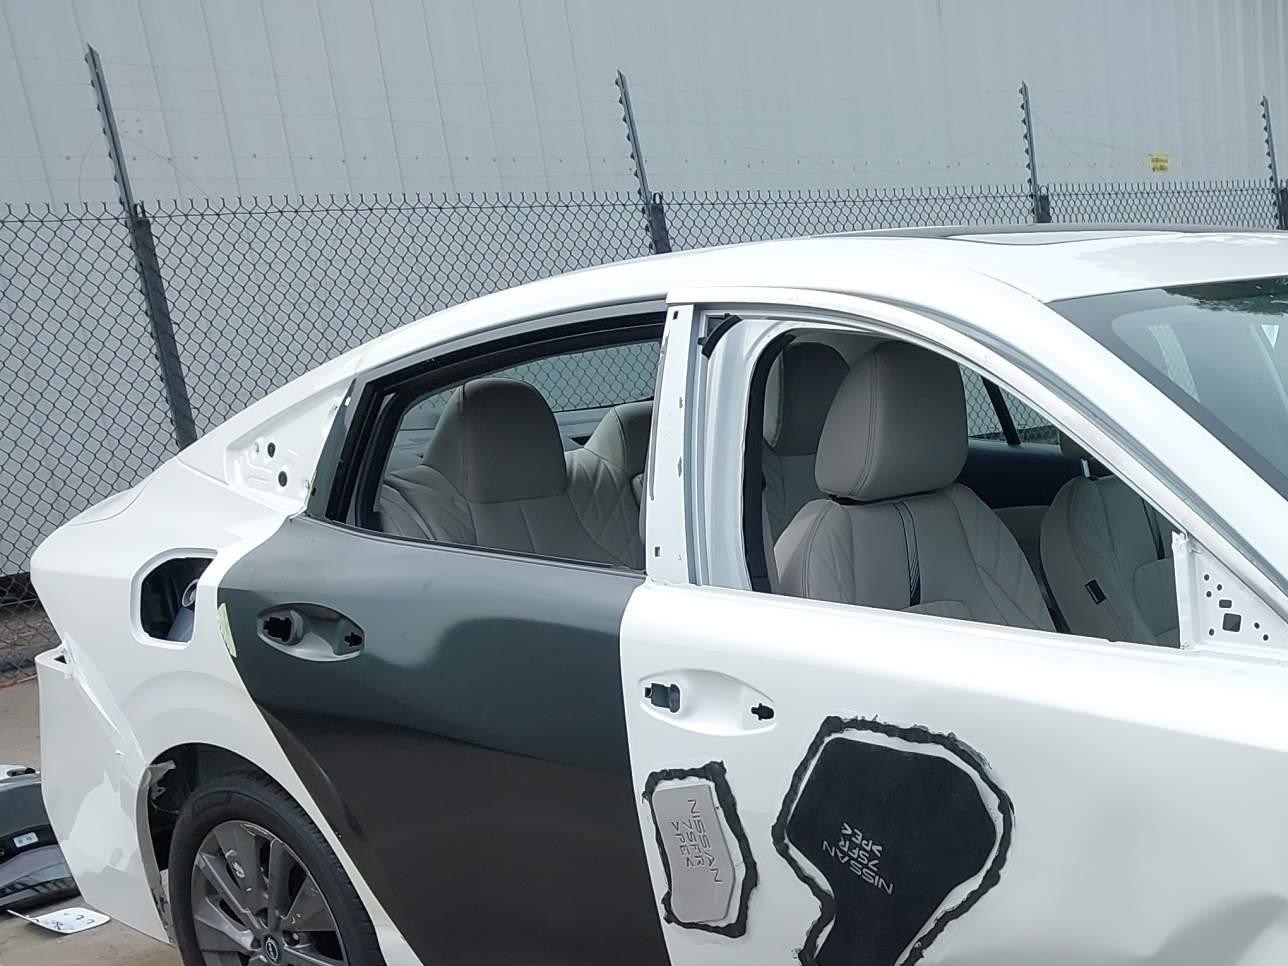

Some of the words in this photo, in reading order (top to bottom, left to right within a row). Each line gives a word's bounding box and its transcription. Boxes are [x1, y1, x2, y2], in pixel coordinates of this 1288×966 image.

[682, 819, 705, 867] 7SFR
[687, 799, 723, 883] NISSAN
[838, 837, 880, 872] 7SFR
[822, 840, 894, 894] NISSAN
